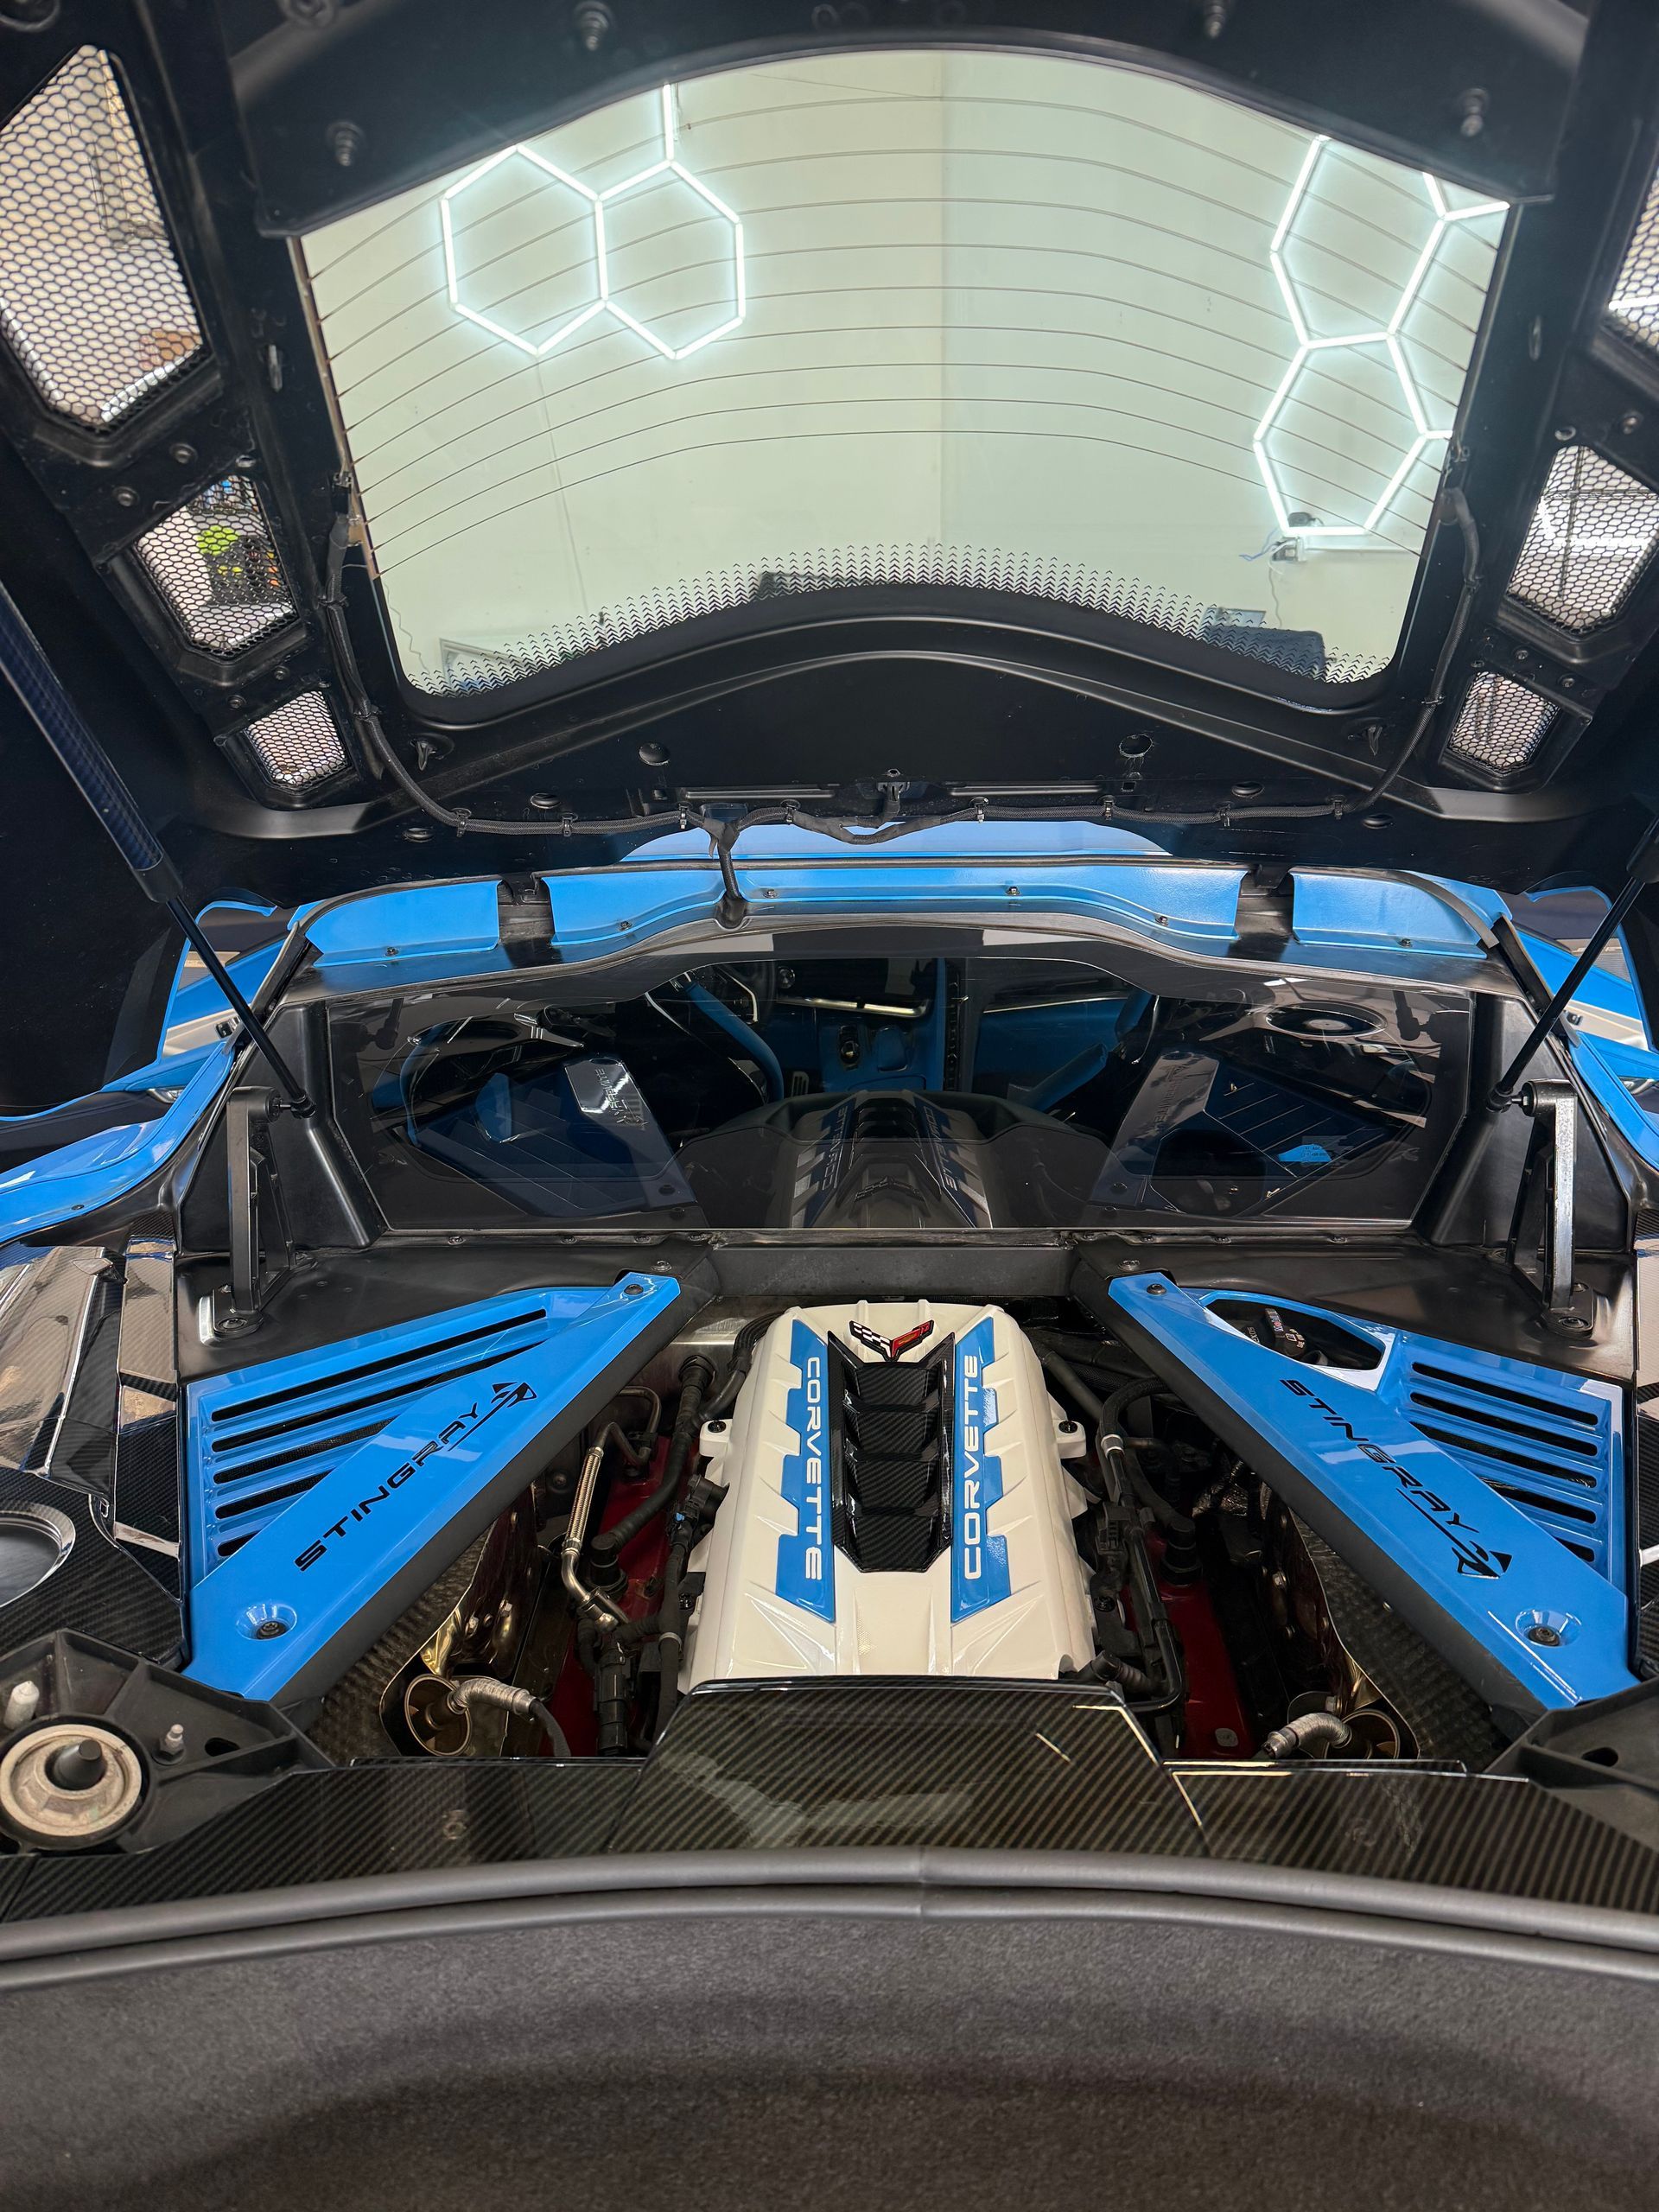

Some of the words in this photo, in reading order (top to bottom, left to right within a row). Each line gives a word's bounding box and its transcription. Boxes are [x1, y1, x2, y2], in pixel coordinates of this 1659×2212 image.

[294, 1402, 478, 1572] STINGRAY
[805, 1357, 822, 1580] CORVETTE
[963, 1355, 982, 1580] CORVETTE
[1280, 1378, 1479, 1534] STINGRAY
